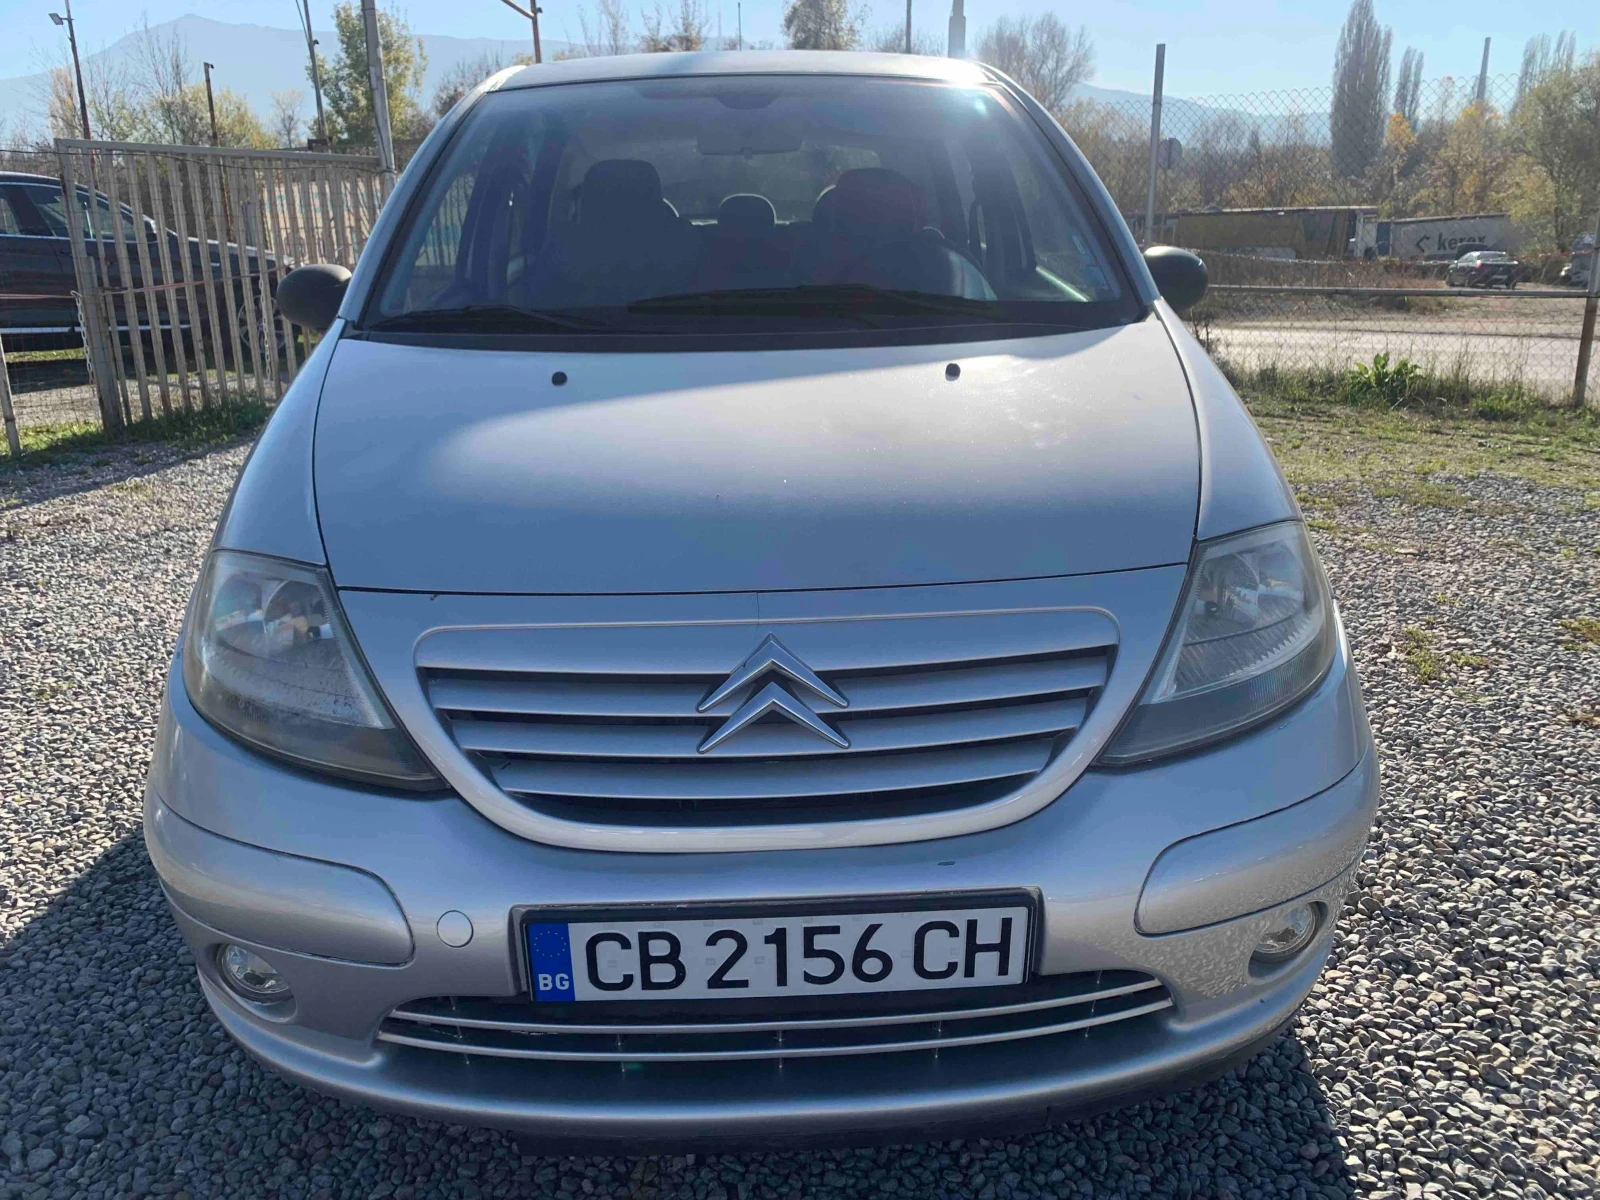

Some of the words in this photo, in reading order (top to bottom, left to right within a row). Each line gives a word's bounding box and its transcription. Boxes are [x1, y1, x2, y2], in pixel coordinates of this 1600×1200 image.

[585, 930, 687, 992] CB
[705, 923, 894, 989] 2156
[912, 917, 1014, 980] CH
[538, 973, 570, 991] BG
